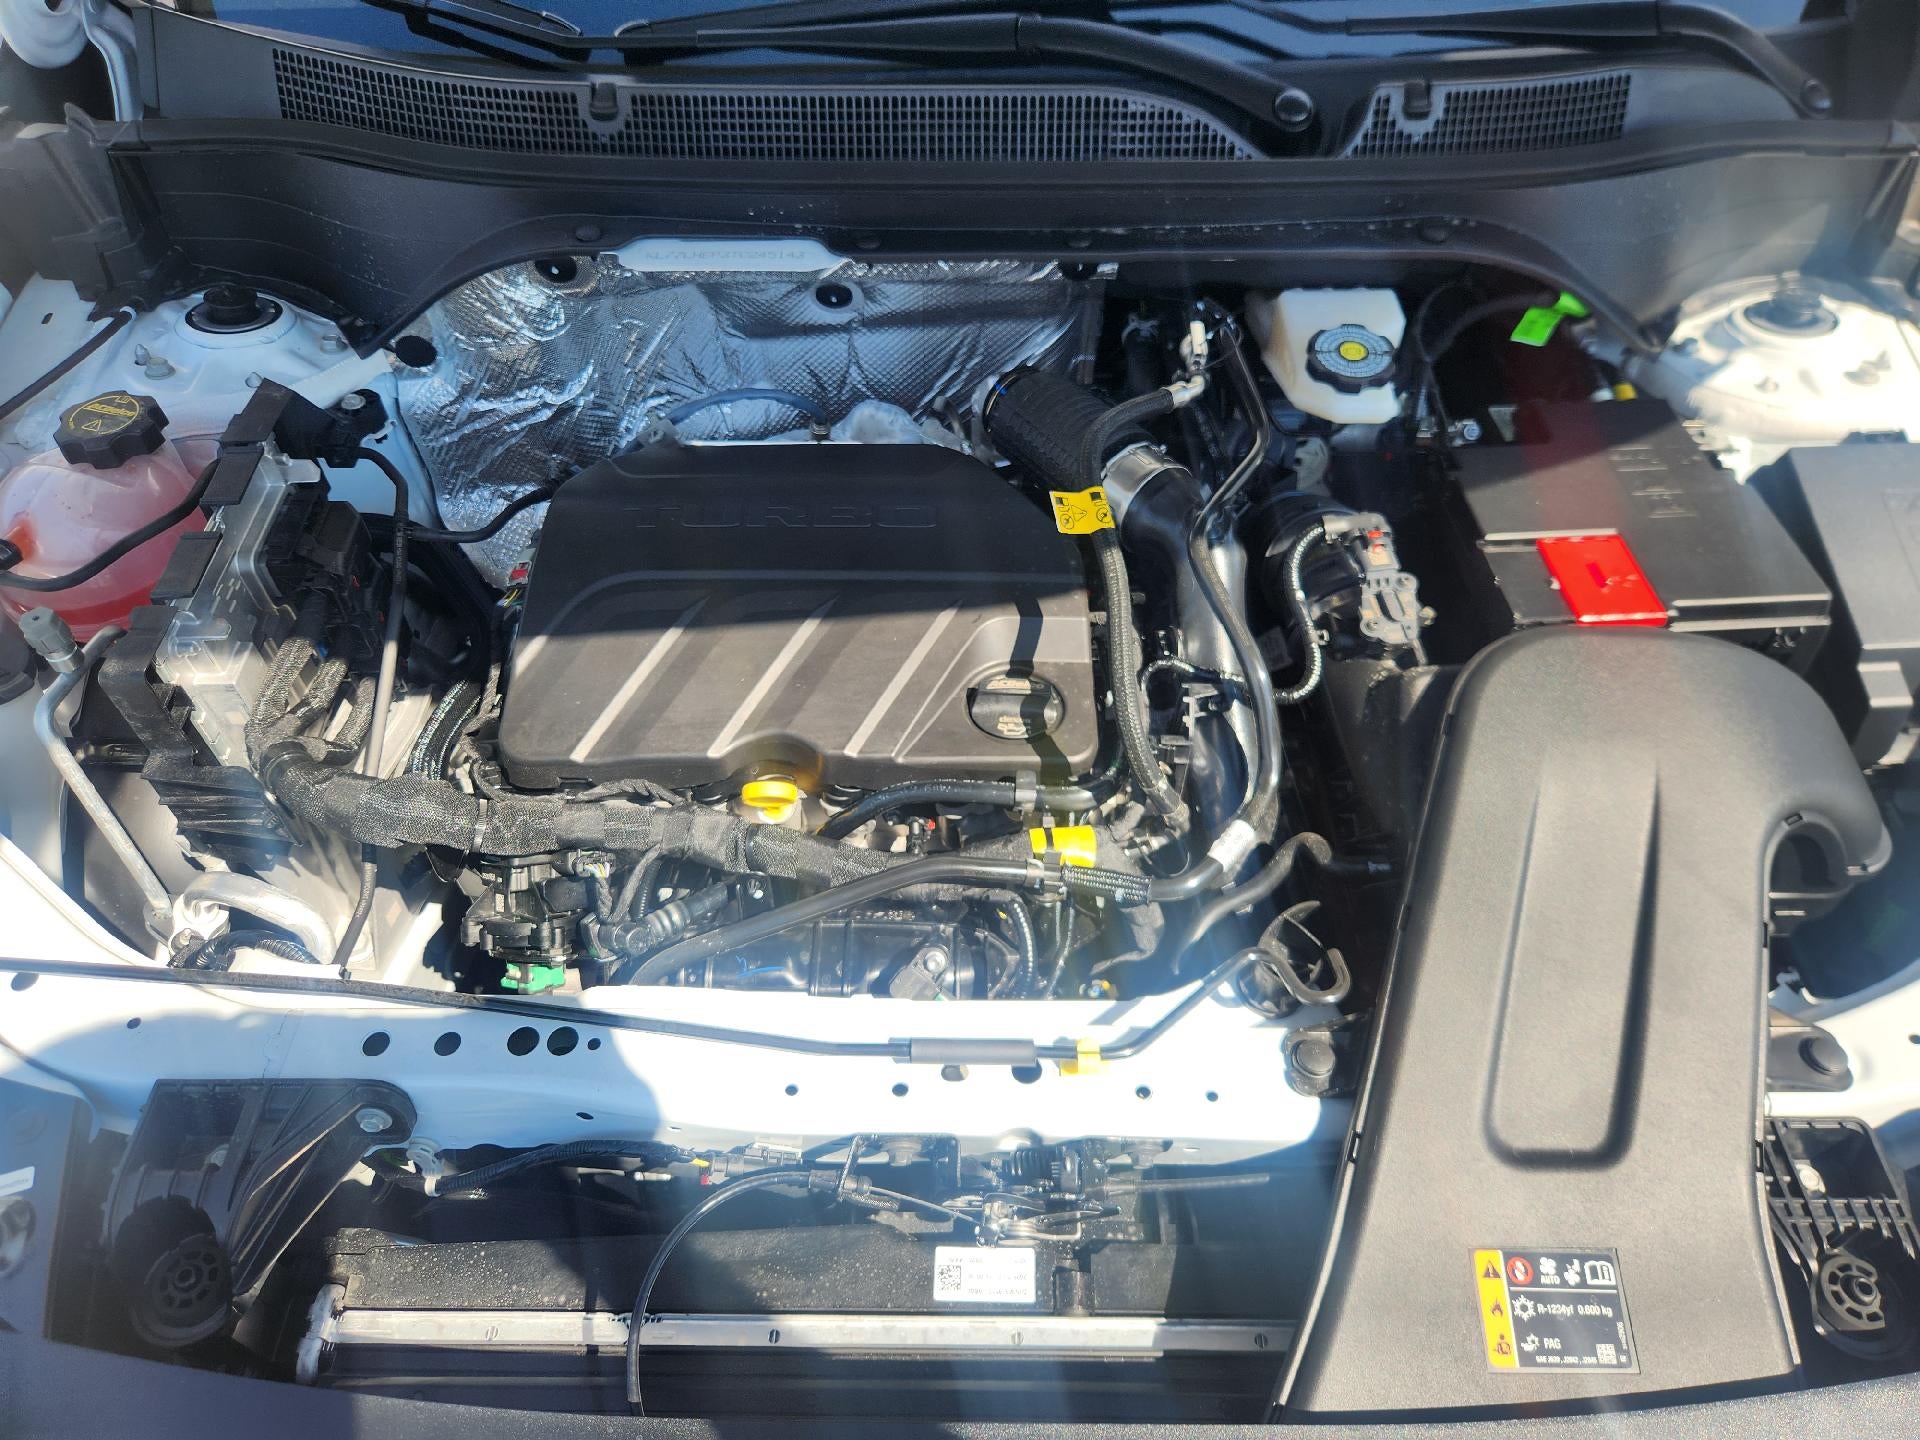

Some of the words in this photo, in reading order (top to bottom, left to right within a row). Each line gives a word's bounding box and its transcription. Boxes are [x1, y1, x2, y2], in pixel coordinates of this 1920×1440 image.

[623, 506, 937, 528] TURBO
[1540, 1275, 1561, 1285] AUTO
[1536, 1303, 1575, 1318] R-1234yf
[1601, 1305, 1614, 1319] kg
[1543, 1337, 1562, 1350] PAG
